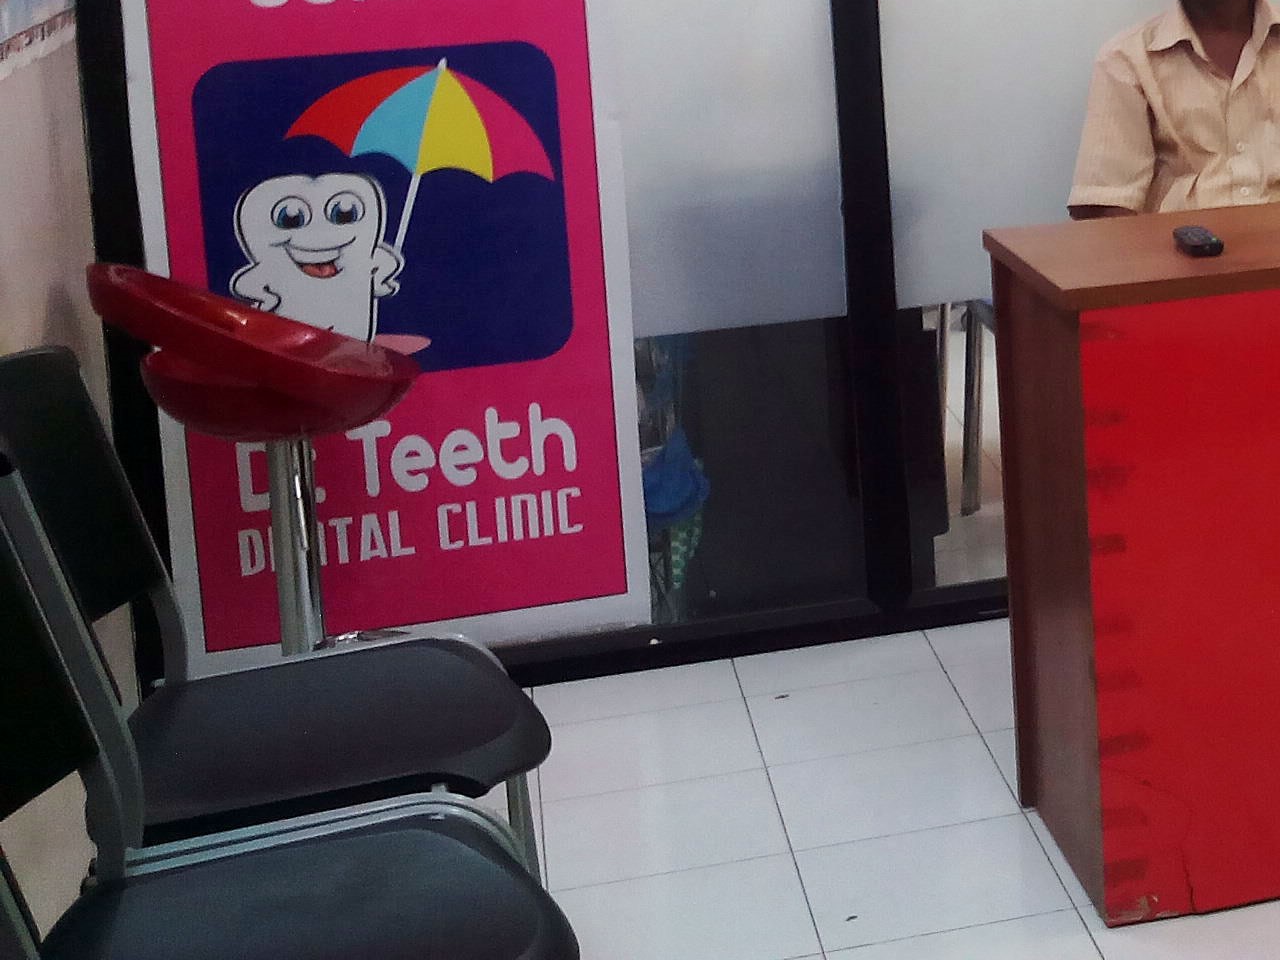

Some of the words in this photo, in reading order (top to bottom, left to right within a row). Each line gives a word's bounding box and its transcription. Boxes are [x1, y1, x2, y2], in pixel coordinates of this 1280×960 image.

[346, 402, 577, 498] Teeth
[238, 509, 415, 578] DTAL
[437, 487, 583, 551] CLINIC
